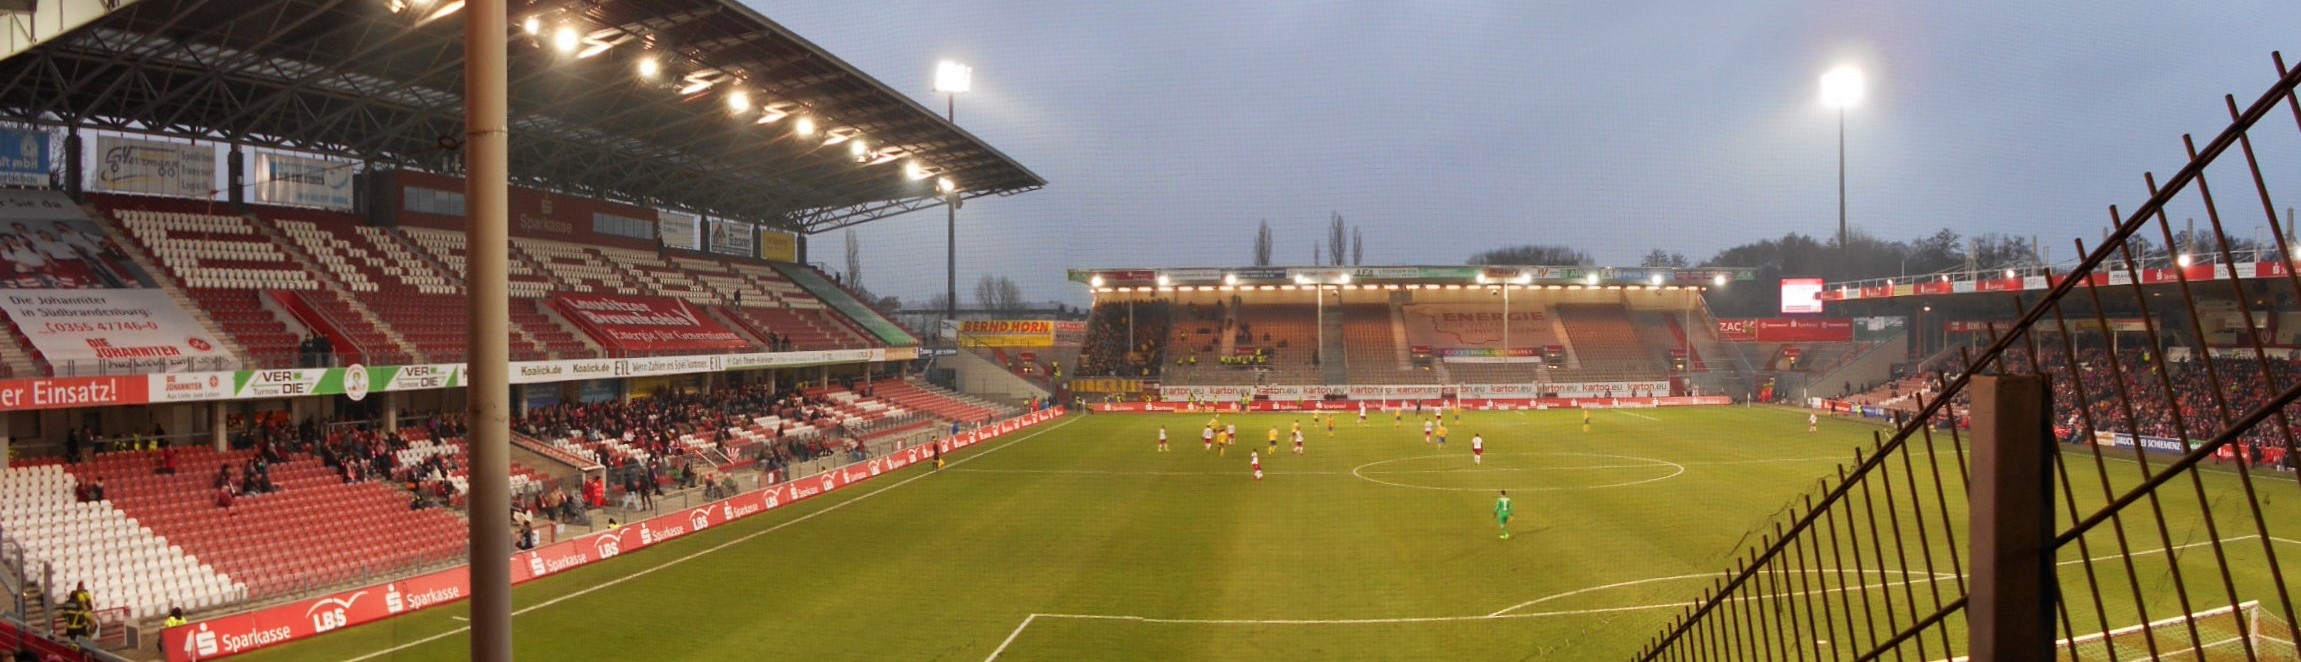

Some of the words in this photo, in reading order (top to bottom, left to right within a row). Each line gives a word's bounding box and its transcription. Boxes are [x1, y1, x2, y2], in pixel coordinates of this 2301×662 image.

[519, 212, 573, 234] Sparkasse
[9, 295, 32, 305] Die
[38, 296, 108, 305] Johanniter
[563, 297, 652, 312] Lausitzer
[20, 308, 36, 317] in
[580, 310, 692, 326] Braunkohle
[1442, 312, 1545, 322] ENERGIE
[963, 321, 1008, 333] BERND
[1011, 321, 1049, 333] HORN
[1720, 322, 1742, 332] ZAC
[86, 338, 112, 348] DIE
[96, 345, 181, 359] JOHANNITER
[572, 364, 610, 374] Koalick.de
[614, 360, 631, 376] ETL
[709, 356, 723, 370] ETL
[262, 371, 292, 383] VER
[405, 366, 429, 376] VER
[520, 365, 562, 376] Koalick.de
[282, 383, 304, 394] DIE
[420, 377, 438, 387] DIE
[1, 388, 24, 406] er
[33, 378, 117, 405] Einsatz!
[1162, 387, 1204, 396] karton.eu
[1303, 386, 1344, 396] karton.eu
[1397, 386, 1439, 395] karton.eu
[1491, 385, 1532, 394] karton.eu
[1627, 383, 1667, 392] karton.eu
[692, 515, 709, 531] LBS
[652, 525, 684, 543] Sparkasse
[598, 542, 619, 559] LBS
[546, 552, 587, 573] Sparkasse
[406, 583, 460, 610] Sparkasse
[313, 607, 348, 632] LBS
[222, 622, 292, 652] Sparkasse
